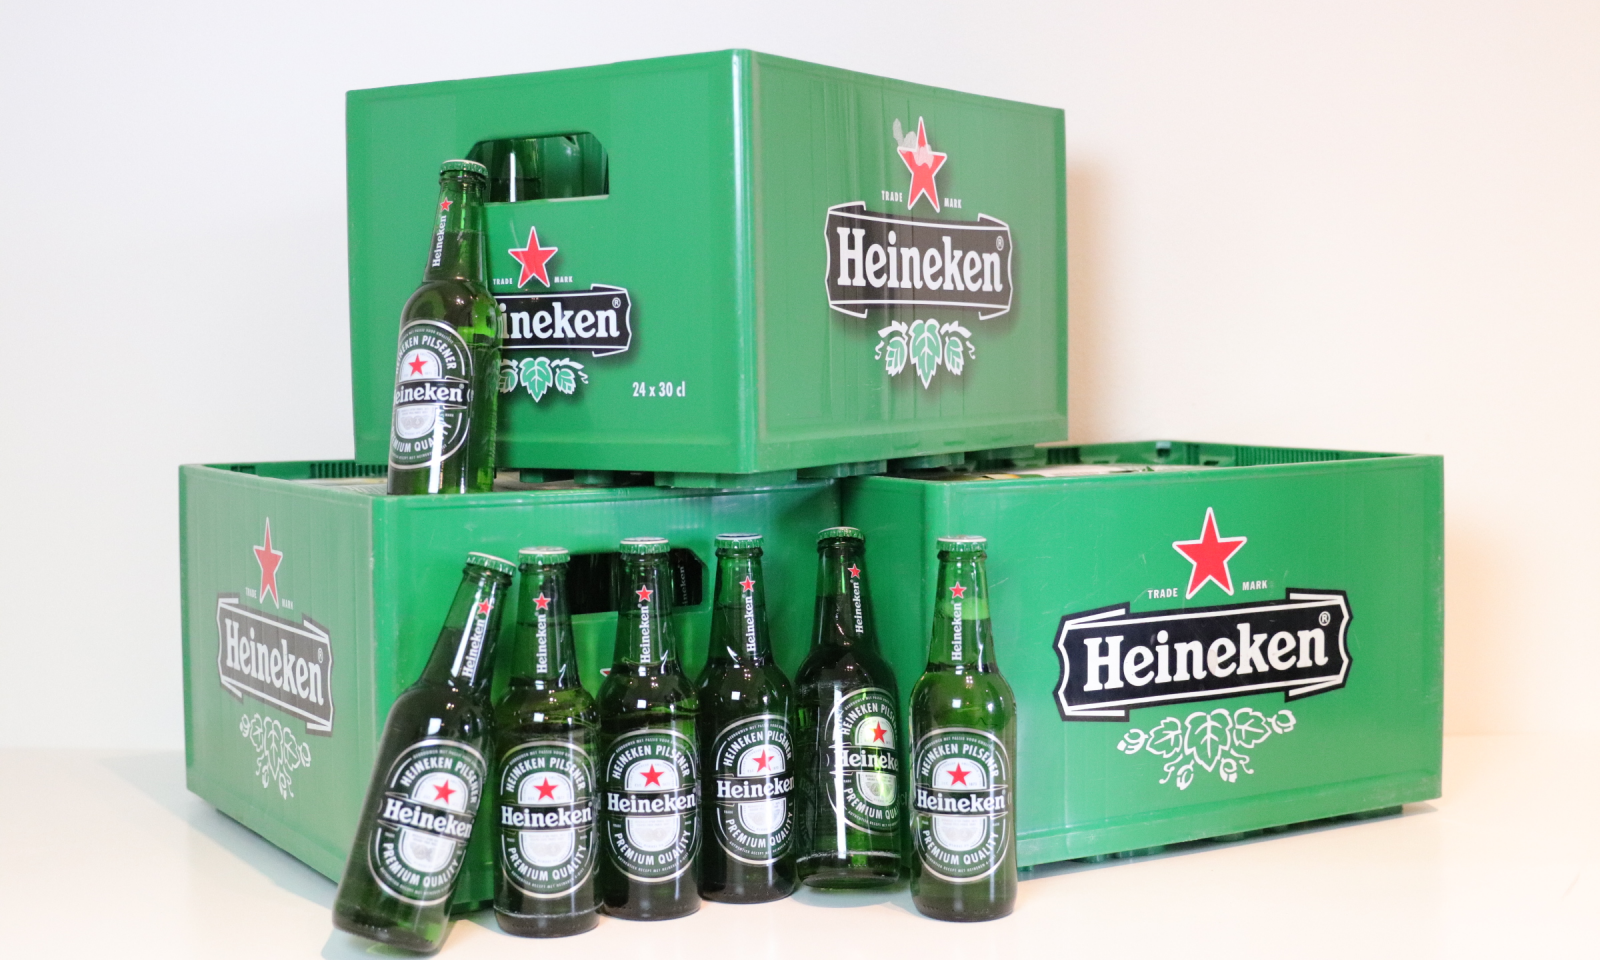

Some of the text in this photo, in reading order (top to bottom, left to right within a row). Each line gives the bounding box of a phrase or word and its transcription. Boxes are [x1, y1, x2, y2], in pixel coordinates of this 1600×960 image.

[881, 190, 962, 208] TRADE MARK
[432, 214, 447, 268] Heineken
[493, 278, 513, 286] TRADE
[421, 335, 457, 370] PILSENER
[395, 383, 463, 404] eineken
[632, 381, 686, 397] 24 x 30 cl
[852, 581, 864, 634] Heineken
[1147, 580, 1268, 600] TRADE MARK
[640, 605, 651, 663] Heineken
[745, 596, 756, 652] Heineken
[951, 602, 962, 661] Heineken
[461, 618, 486, 678] Heineken
[536, 614, 548, 673] Heineken
[841, 702, 878, 735] HEINEKEN
[612, 745, 652, 779] HEINEKEN
[656, 745, 689, 777] PILSENER
[722, 730, 792, 767] HEINEKEN PILSENER
[834, 750, 898, 773] Heineke
[921, 743, 999, 777] HEINEKEN PILSENER
[400, 757, 453, 787] HEINEKEN
[455, 760, 478, 803] PILSENER
[505, 757, 545, 792] HEINEKEN
[550, 757, 586, 790] PILSENER
[717, 776, 794, 798] Heineken
[501, 805, 592, 827] Heineken
[607, 792, 696, 813] Heineken
[844, 787, 883, 819] PREMIUM
[917, 788, 1005, 813] Heineken
[383, 798, 472, 839] Heineken
[726, 818, 766, 849] PREMIUM
[769, 812, 793, 847] QUALITY
[382, 842, 420, 887] PREMIUM
[423, 859, 459, 888] QUALITY
[507, 847, 548, 881] PREMIUM
[552, 845, 587, 880] QUALITY
[614, 832, 654, 866] PREMIUM
[658, 830, 691, 865] QUALITY
[922, 830, 959, 865] PREMIUM
[963, 833, 998, 865] QUALITY
